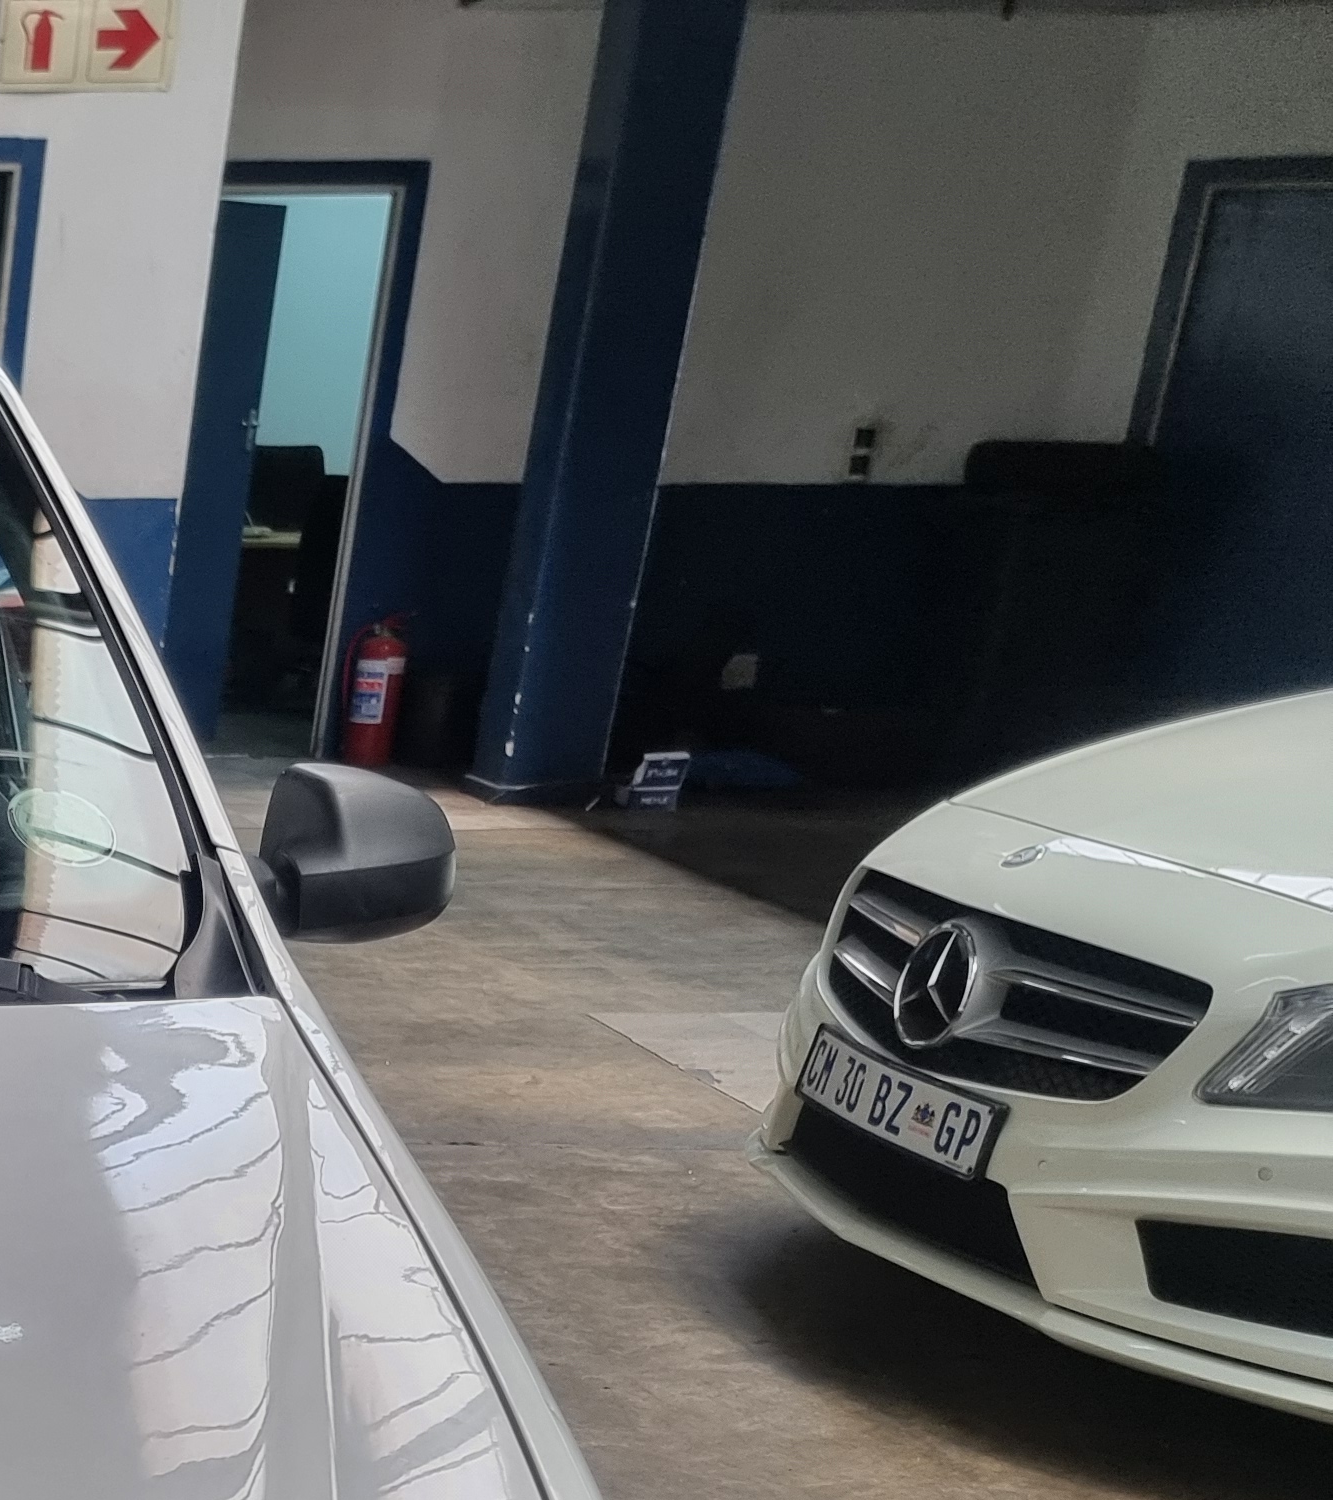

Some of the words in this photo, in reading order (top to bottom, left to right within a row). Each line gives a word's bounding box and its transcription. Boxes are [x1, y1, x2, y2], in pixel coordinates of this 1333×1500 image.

[807, 1039, 839, 1096] CM
[834, 1056, 867, 1114] 30
[867, 1073, 913, 1136] BZ
[934, 1101, 981, 1161] GP
